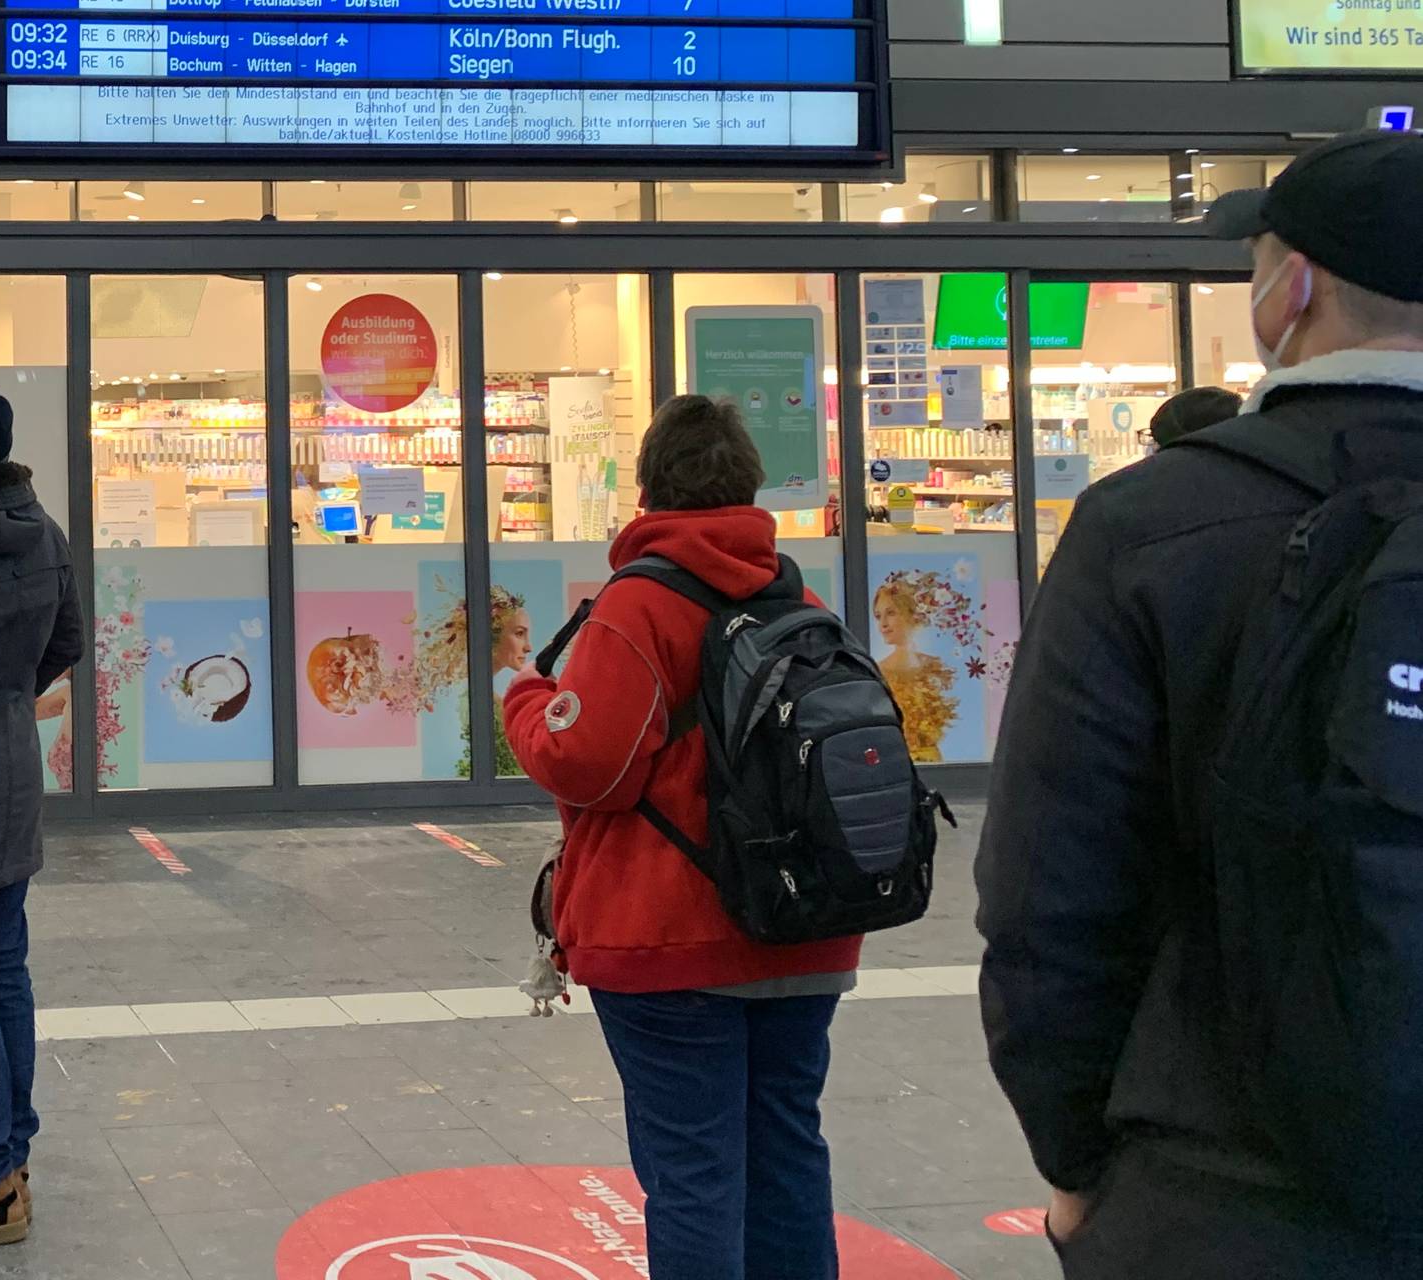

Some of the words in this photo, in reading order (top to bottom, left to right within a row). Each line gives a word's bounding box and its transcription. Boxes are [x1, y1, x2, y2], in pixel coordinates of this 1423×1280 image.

[11, 23, 68, 44] 09:32
[81, 29, 99, 42] RE
[106, 30, 115, 42] 6
[123, 30, 160, 44] (RRX)
[170, 32, 229, 48] Duisburg
[253, 32, 328, 47] Düsseldorf
[449, 28, 553, 48] Köln/Bonn
[563, 29, 620, 52] Flugh.
[684, 31, 696, 50] 2
[1286, 26, 1318, 44] Wir
[1324, 27, 1362, 45] sind
[1369, 28, 1398, 45] 365
[11, 49, 68, 70] 09:34
[81, 55, 99, 68] RE
[108, 56, 125, 69] 16
[170, 58, 223, 72] Bochum
[247, 58, 292, 73] Witten
[315, 59, 357, 76] Hagen
[449, 55, 513, 78] Siegen
[673, 57, 696, 76] 10
[98, 85, 129, 98] Bitte
[135, 86, 177, 99] halten
[183, 86, 201, 99] Sie
[207, 86, 230, 99] den
[236, 87, 338, 100] Mindestabstand
[343, 89, 361, 100] ein
[367, 88, 389, 100] und
[395, 88, 454, 101] beachten
[459, 89, 479, 101] Sie
[484, 89, 503, 101] die
[589, 91, 618, 103] einer
[625, 90, 709, 103] medizinischen
[715, 91, 754, 103] Maske
[355, 103, 407, 114] Bahnhof
[413, 103, 436, 114] und
[441, 103, 453, 114] in
[458, 103, 480, 114] den
[106, 113, 167, 126] Extremes
[174, 114, 237, 127] Unwetter:
[243, 114, 332, 128] Auswirkungen
[337, 115, 348, 127] in
[354, 115, 398, 127] weiten
[404, 116, 441, 128] Teilen
[447, 116, 469, 128] des
[475, 116, 518, 128] Landes
[581, 116, 611, 128] Bitte
[617, 117, 687, 129] informieren
[693, 117, 711, 129] Sie
[717, 117, 741, 129] sich
[747, 117, 766, 129] auf
[387, 129, 458, 141] Kostenlose
[464, 129, 508, 141] Hotline
[513, 130, 551, 141] 08000
[556, 130, 601, 141] 996633
[341, 316, 416, 330] Ausbildung
[330, 332, 360, 345] oder
[363, 332, 417, 345] Studium
[949, 335, 975, 346] Bitte
[398, 346, 428, 359] dich.
[705, 349, 745, 361] Herzlich
[747, 349, 804, 361] willkommen
[579, 1173, 646, 1225] Danke.
